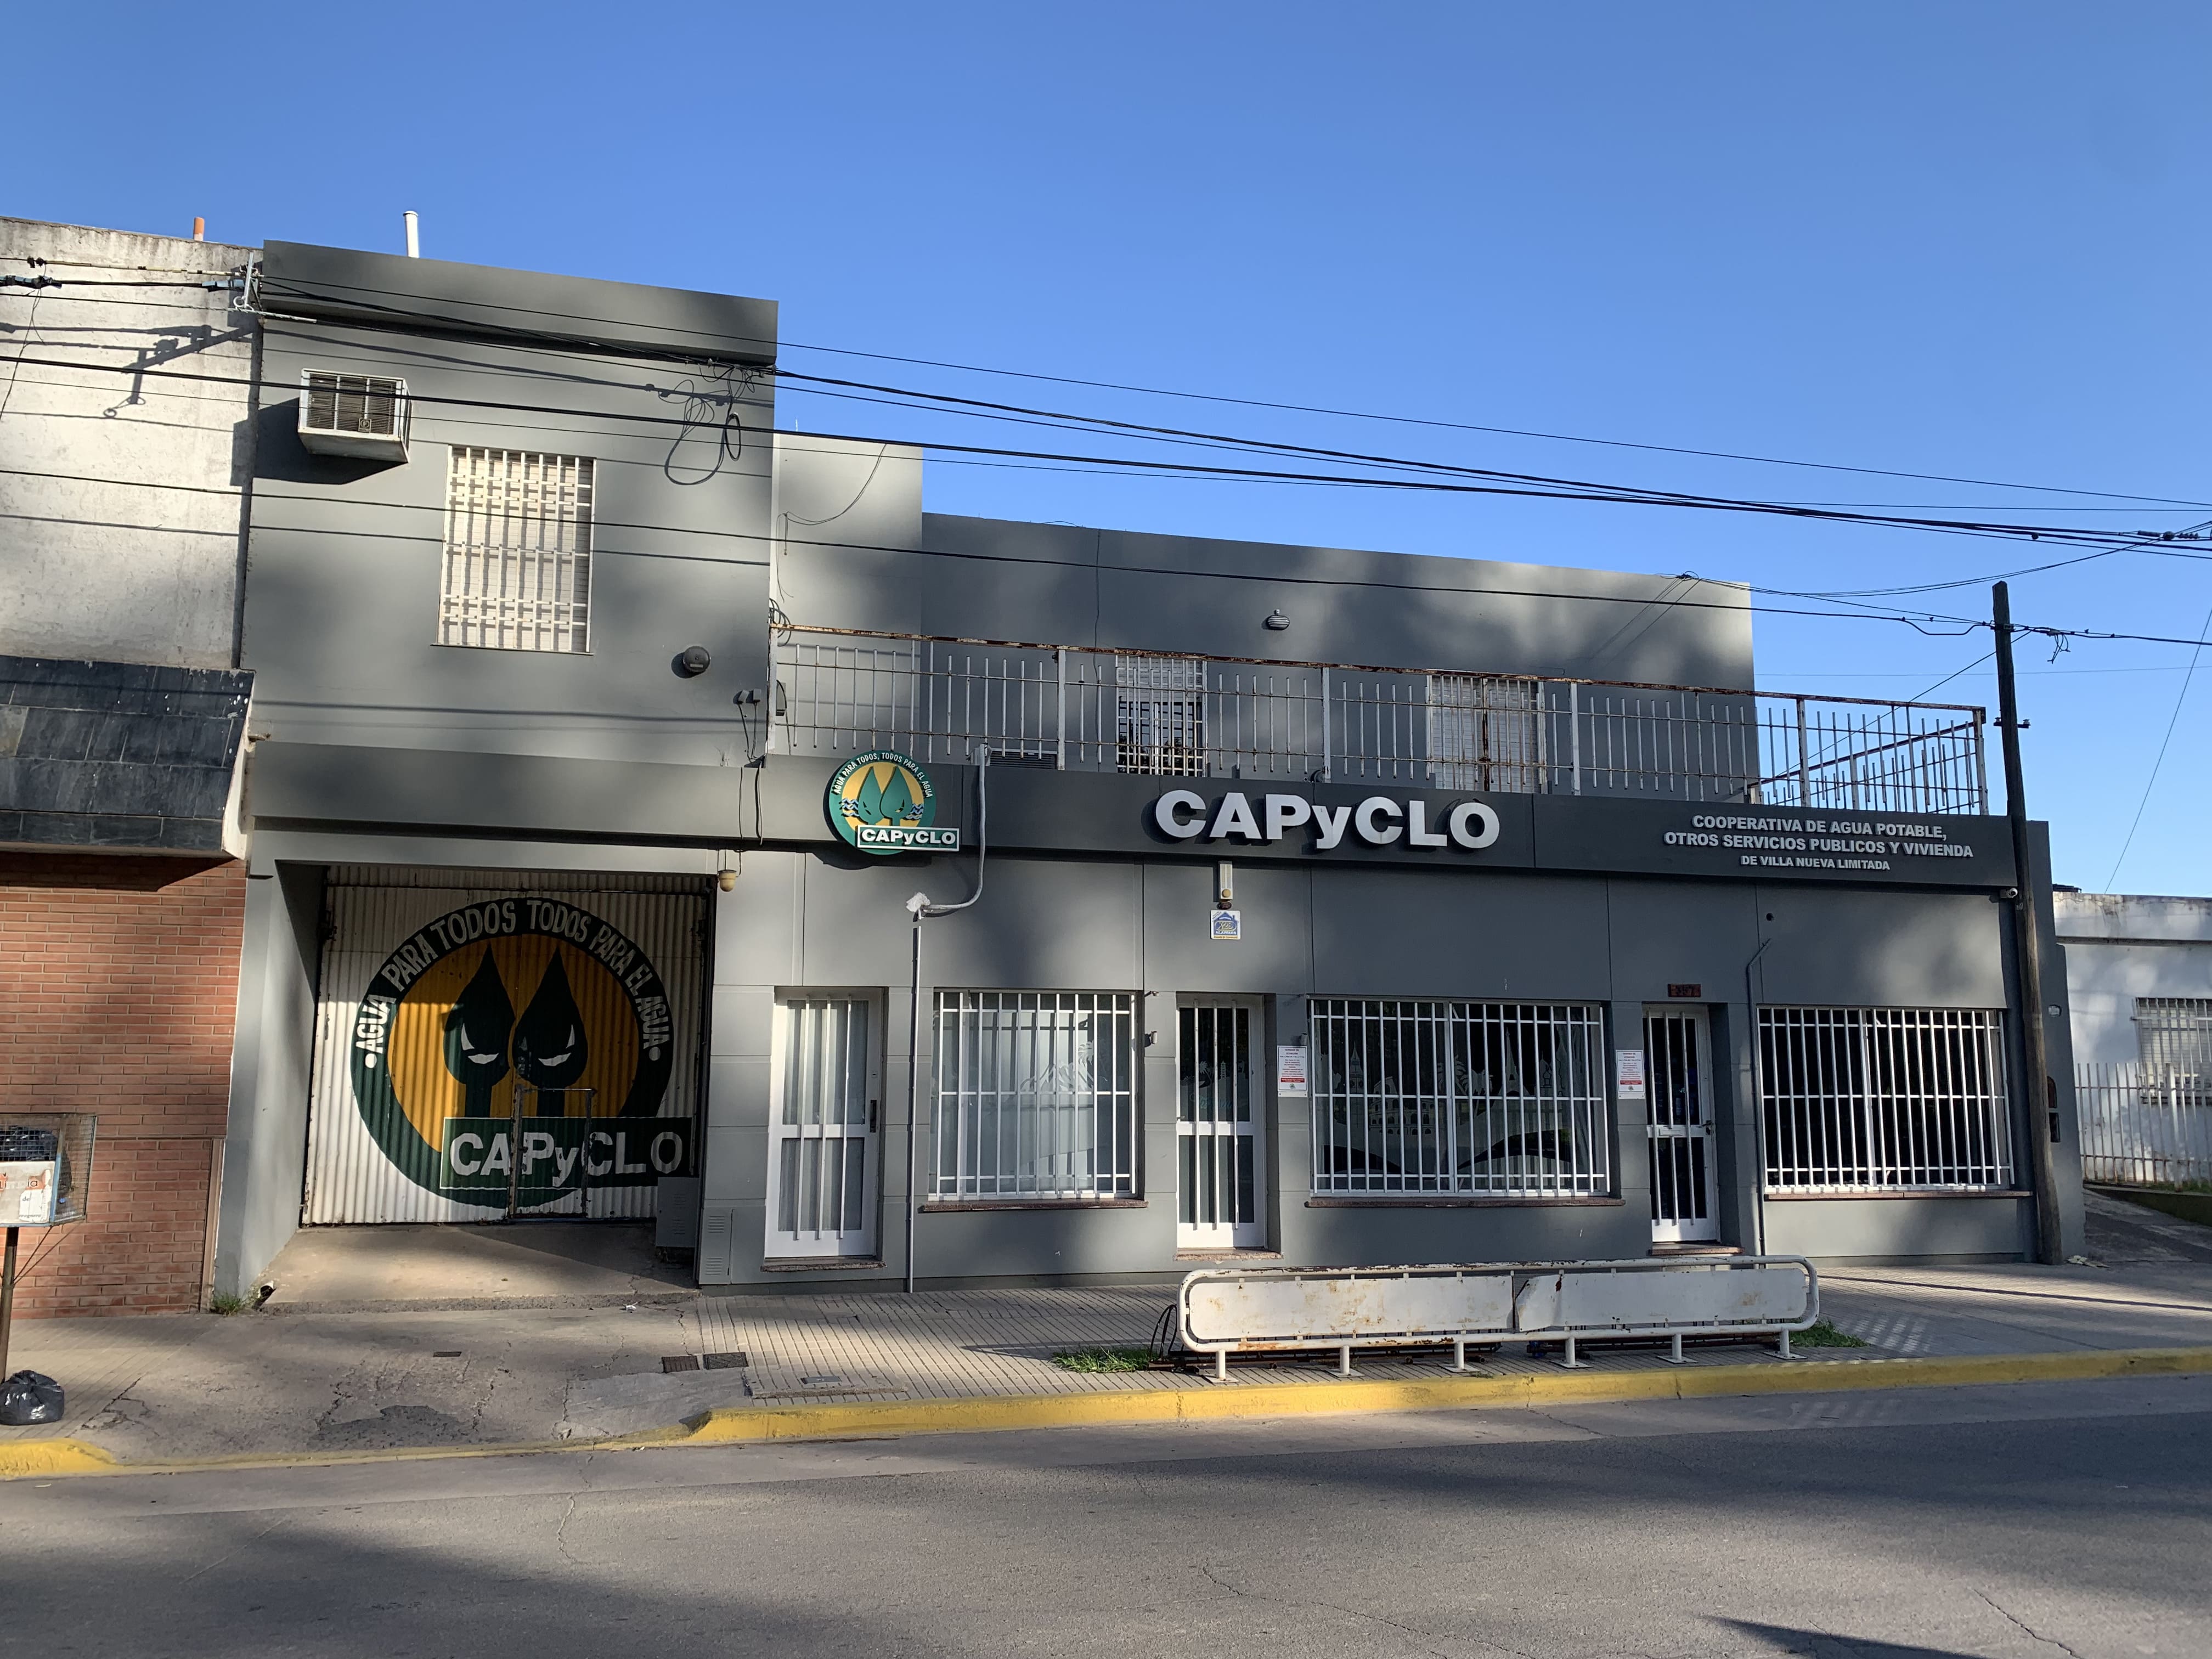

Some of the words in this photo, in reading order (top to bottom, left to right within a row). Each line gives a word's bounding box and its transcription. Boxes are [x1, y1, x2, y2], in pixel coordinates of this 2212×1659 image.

[834, 776, 845, 794] AGUA
[842, 761, 857, 777] PARA
[857, 753, 879, 765] TODOS,
[882, 752, 902, 763] TODOS
[905, 758, 918, 772] PARA
[917, 772, 923, 781] EL
[922, 780, 933, 798] AGUA
[861, 829, 956, 845] CAPyCLO
[1155, 789, 1500, 849] CAPyCLO
[1692, 815, 1802, 832] COOPERATIVA
[1805, 820, 1826, 832] DE
[1830, 821, 1872, 834] AGUA
[1875, 823, 1946, 841] POTABLE,
[1664, 832, 1719, 847] OTROS
[1722, 834, 1806, 850] SERVICIOS
[1810, 838, 1885, 854] PUBLICOS
[1887, 842, 1900, 854] Y
[1903, 843, 1973, 857] VIVIENDA
[1741, 855, 1757, 865] DE
[1759, 856, 1793, 866] VILLA
[1795, 857, 1835, 868] NUEVA
[1838, 859, 1890, 870] LIMITADA
[430, 900, 516, 950] TODOS
[527, 899, 591, 943] TODOS
[381, 935, 439, 992] PARA
[589, 925, 634, 977] PARA
[624, 964, 653, 995] EL
[356, 995, 396, 1054] AGUA
[636, 996, 670, 1049] AGUA
[450, 1131, 682, 1187] CAPyCLO
